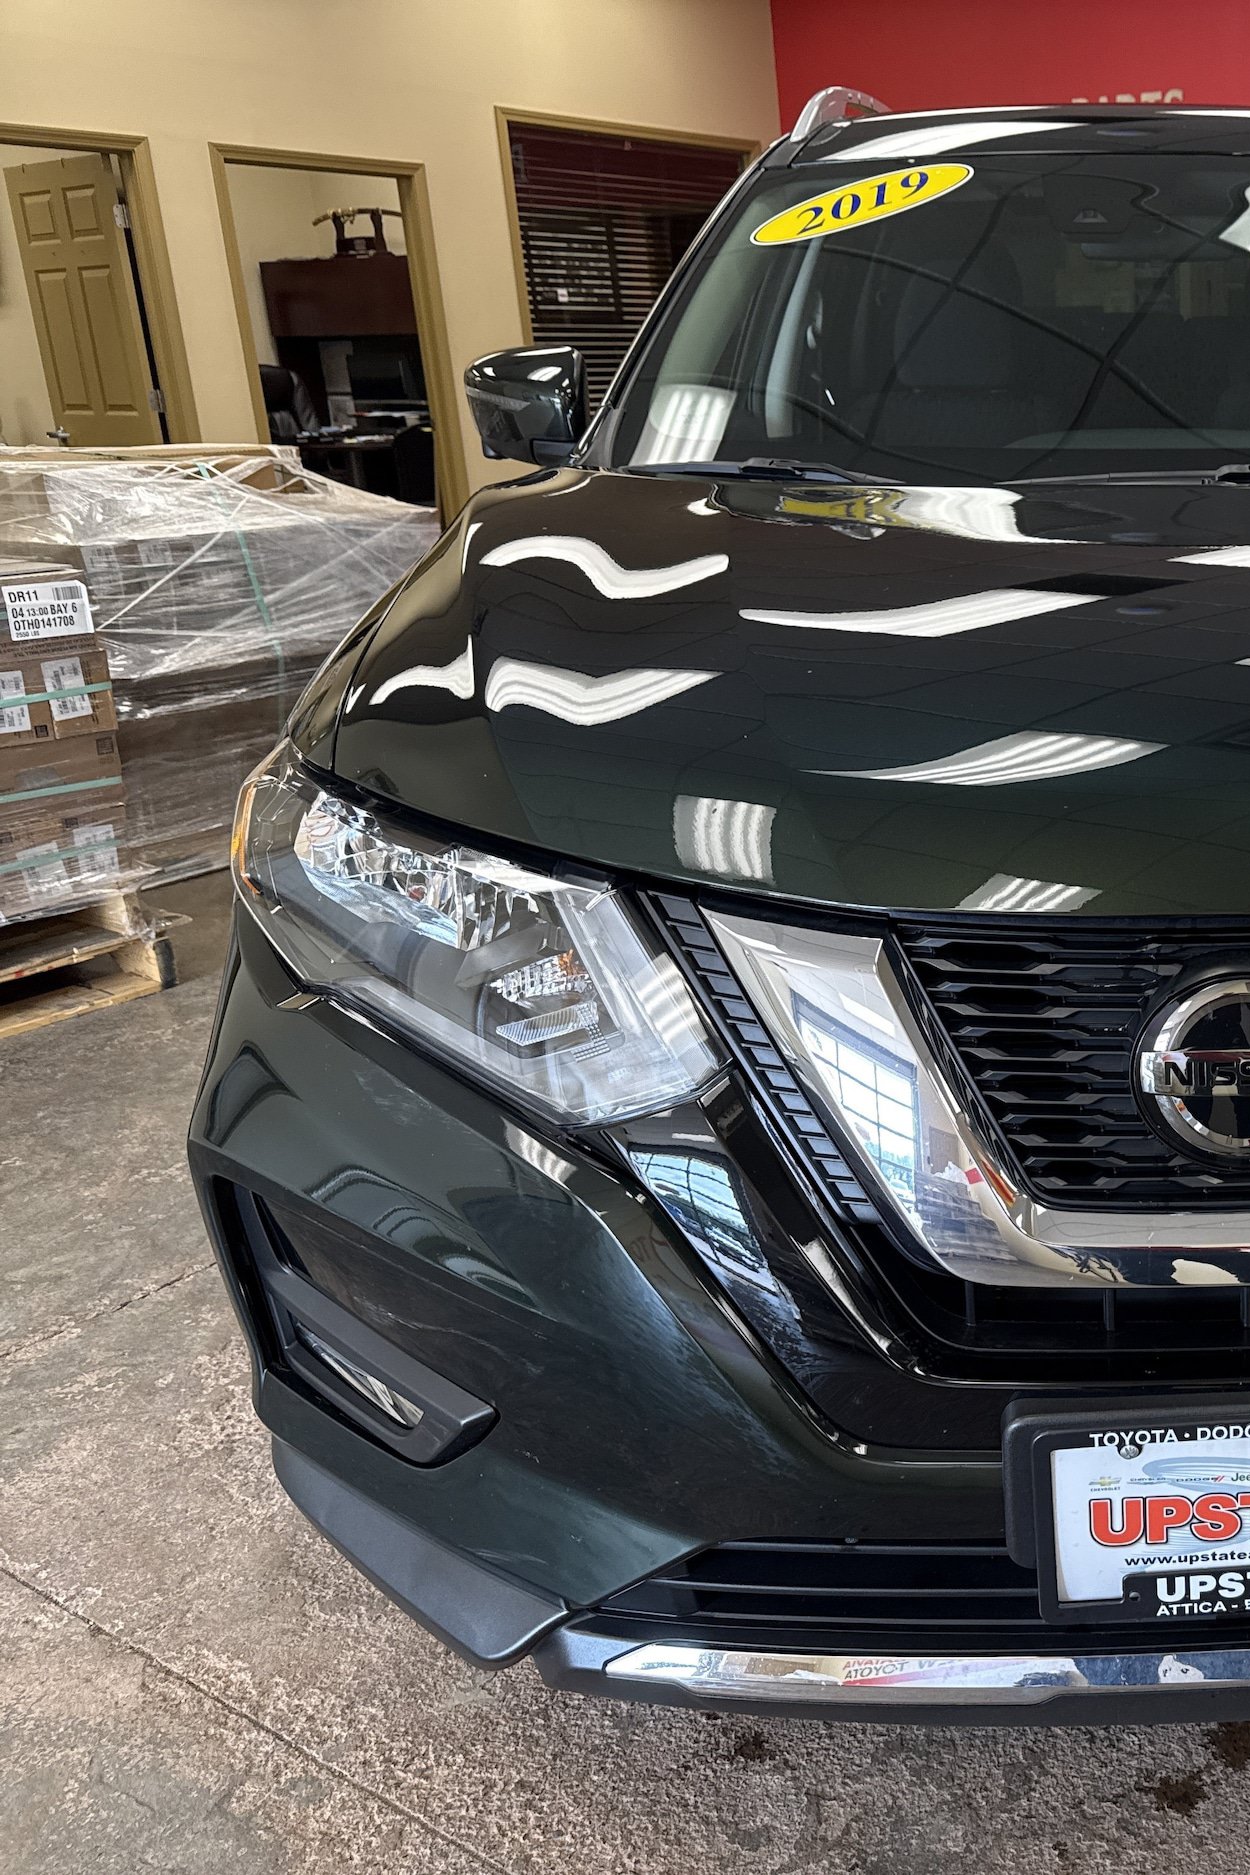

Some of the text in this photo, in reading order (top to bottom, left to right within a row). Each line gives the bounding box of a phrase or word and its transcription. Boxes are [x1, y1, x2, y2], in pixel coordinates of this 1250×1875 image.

[797, 172, 928, 236] 2019
[8, 589, 39, 603] DR11
[11, 602, 78, 619] 04 13:00 BAY 6
[1089, 1429, 1179, 1448] TOYOTA
[1156, 1600, 1227, 1617] ATTICA
